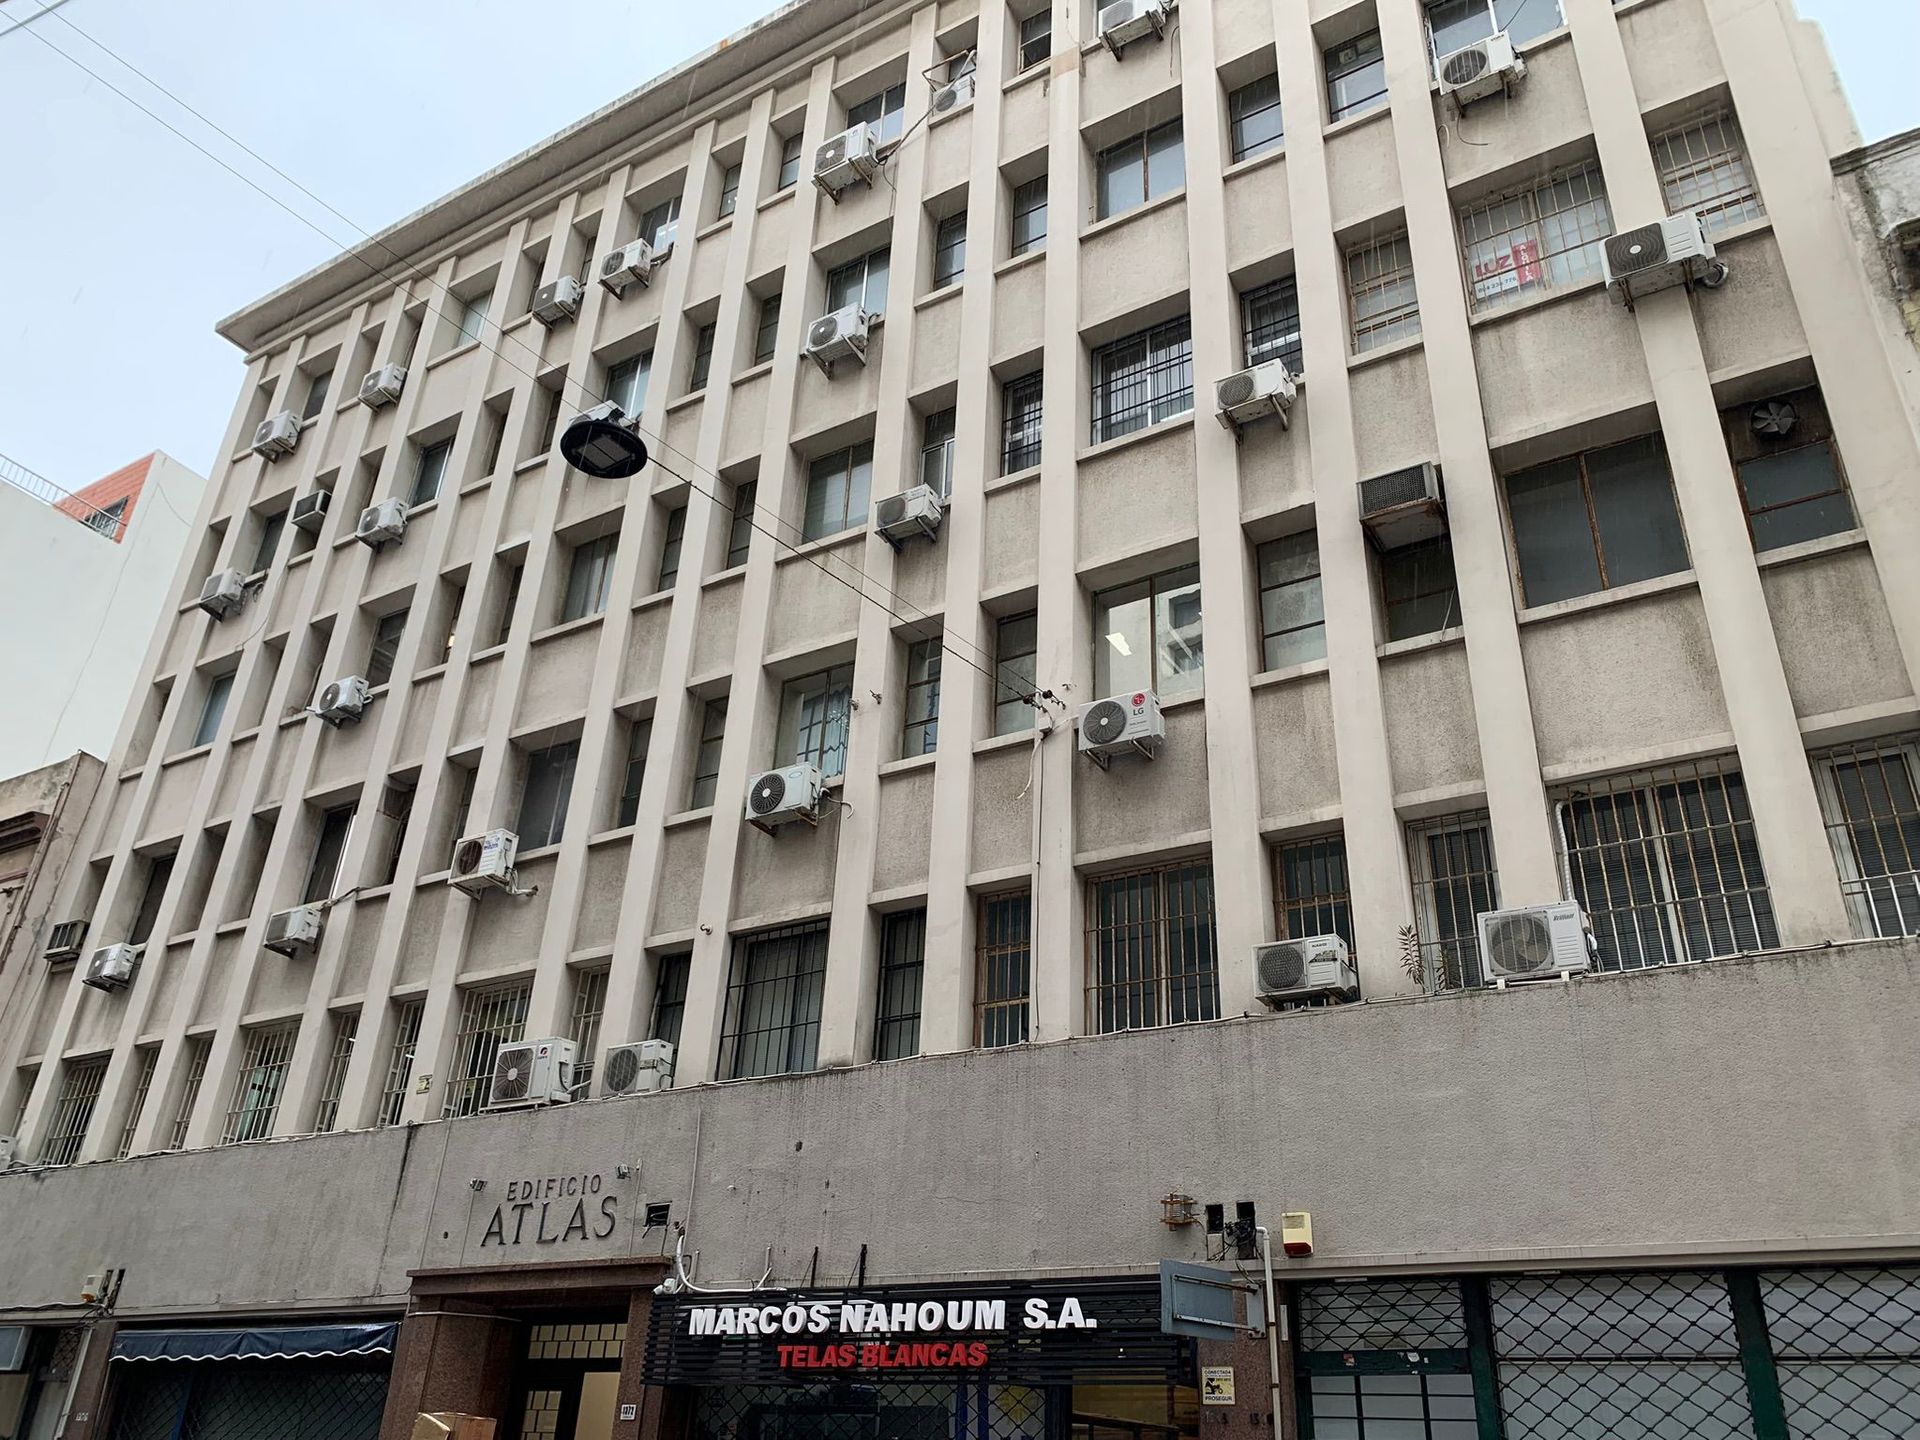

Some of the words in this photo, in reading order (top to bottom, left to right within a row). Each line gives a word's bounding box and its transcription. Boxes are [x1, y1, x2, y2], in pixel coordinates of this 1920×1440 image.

[1475, 255, 1512, 278] LUZ
[1133, 707, 1144, 716] LG
[507, 1174, 601, 1201] EDIFICIO
[480, 1196, 618, 1247] ATLAS
[688, 1304, 831, 1335] MARCOS
[839, 1300, 1006, 1333] NAHOUM
[1023, 1297, 1098, 1329] S.A.
[777, 1344, 857, 1368] TELAS
[861, 1342, 988, 1368] BLANCAS
